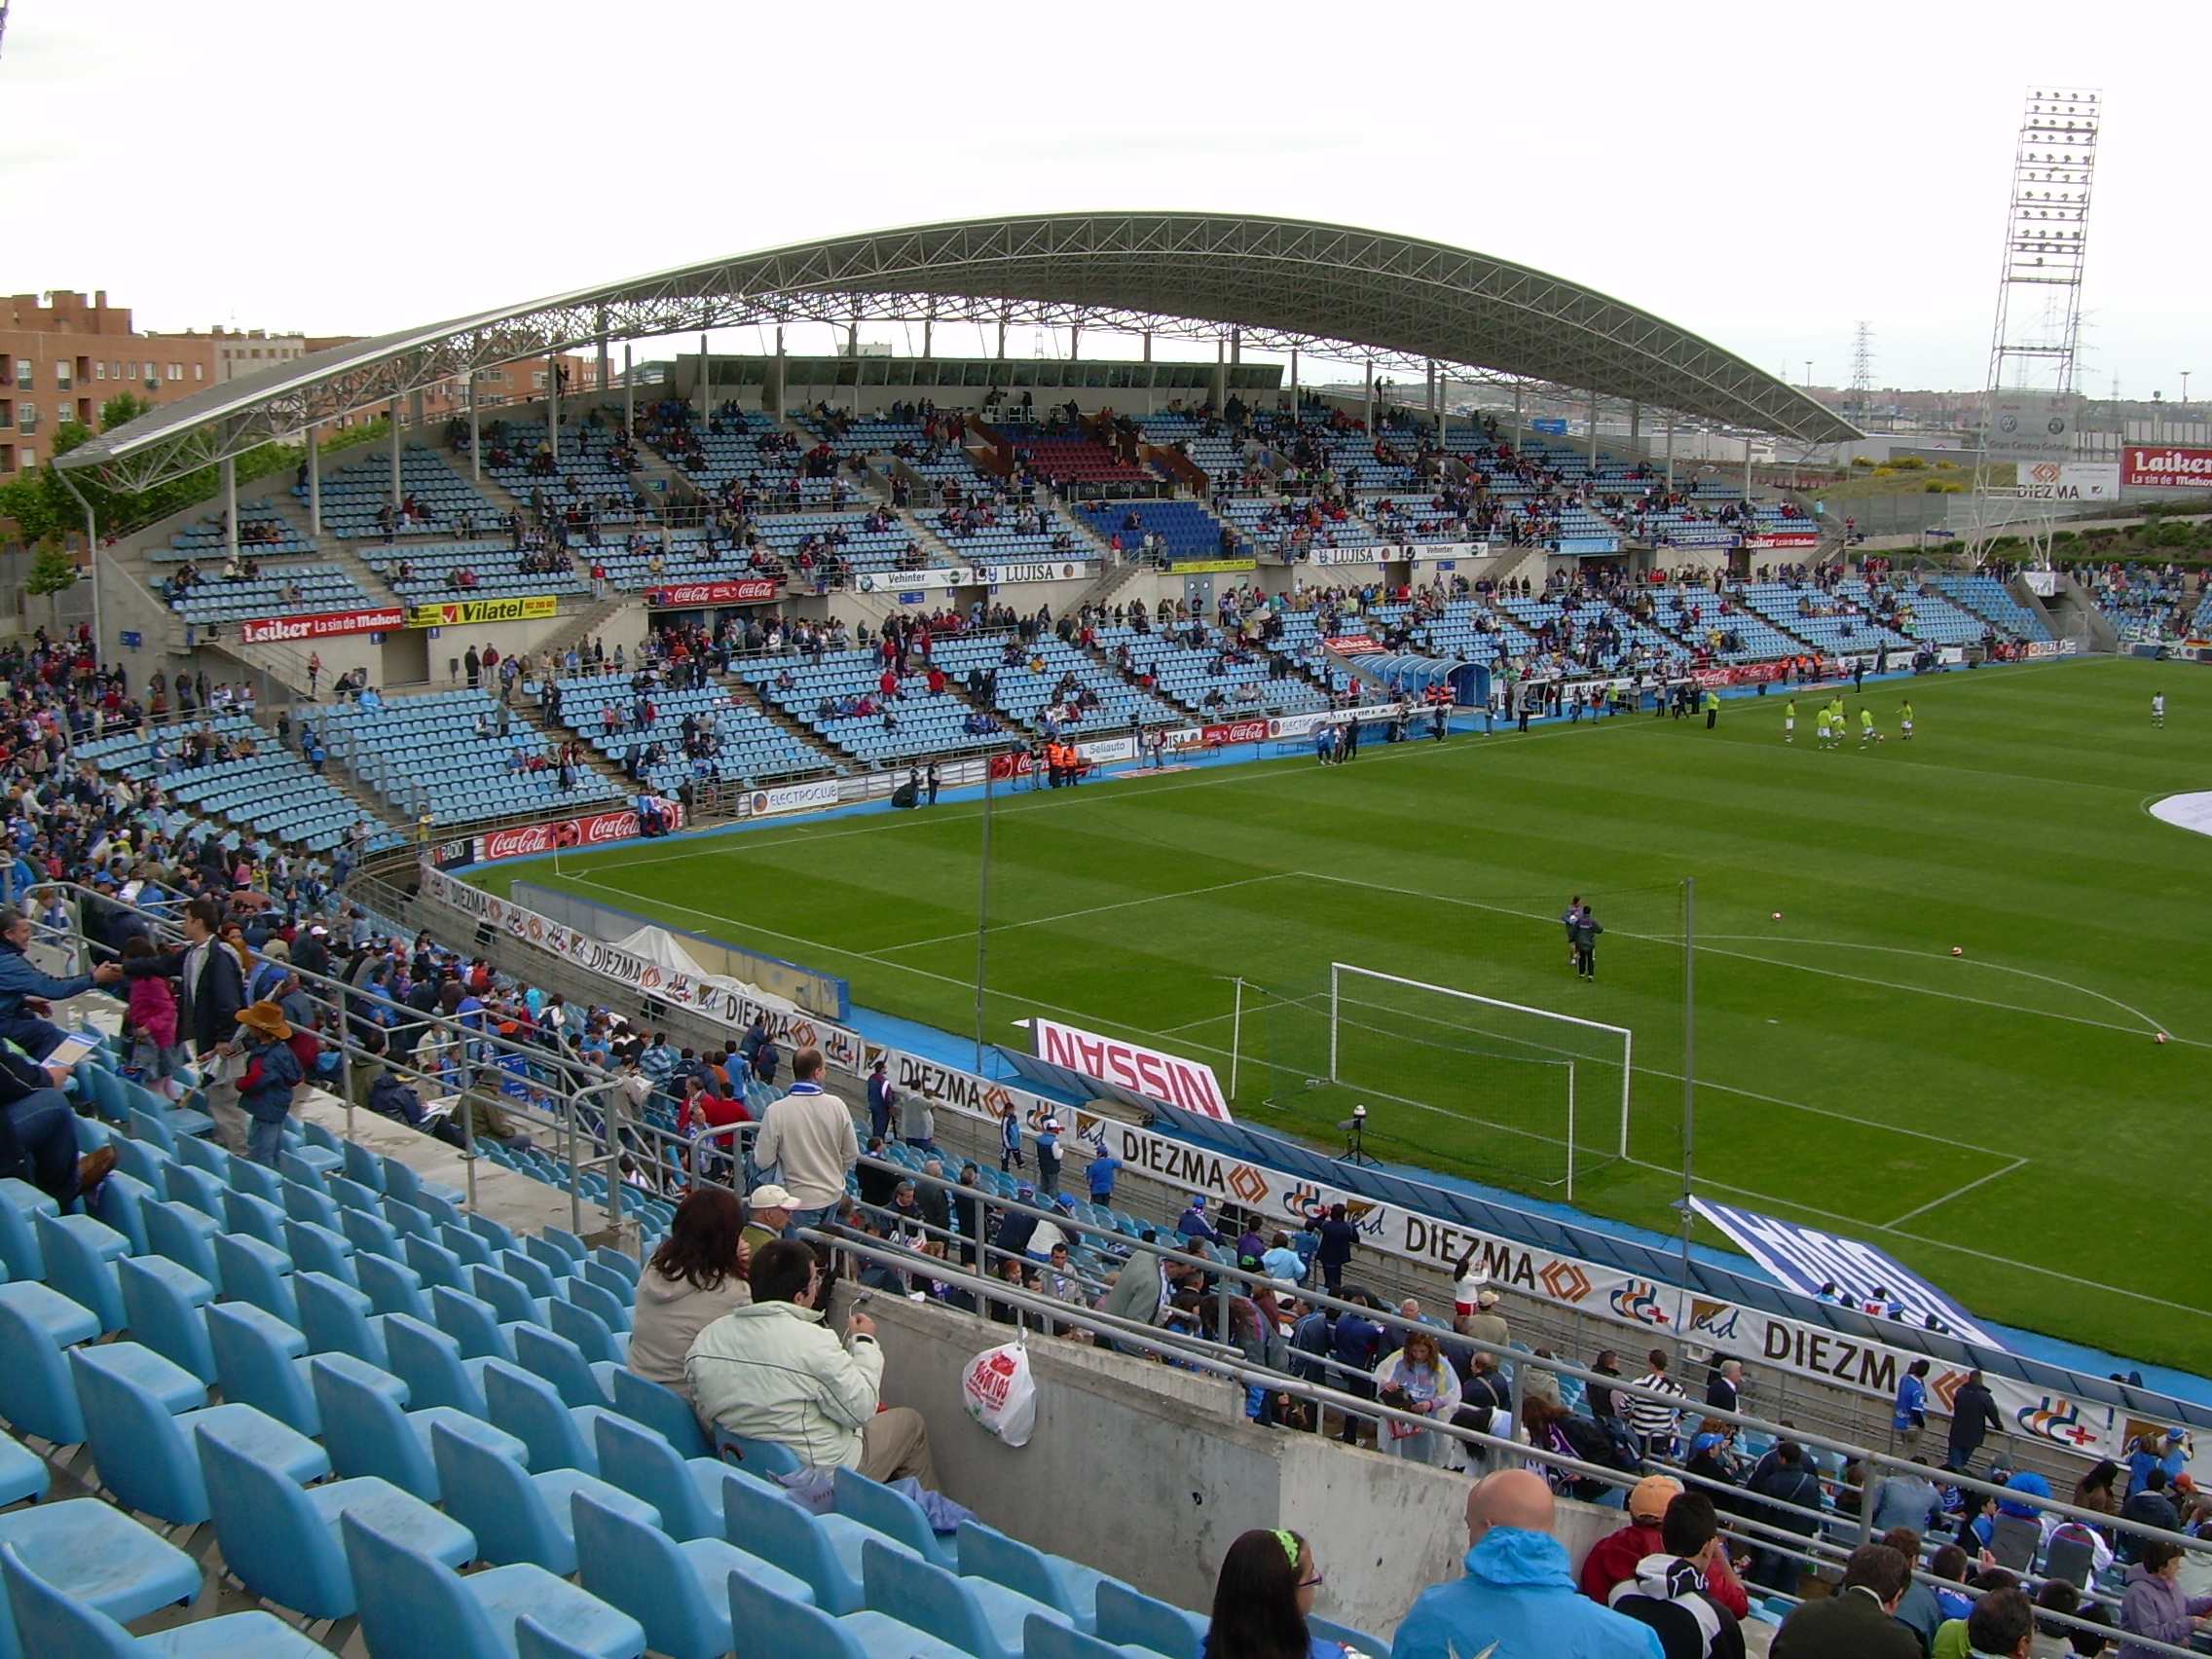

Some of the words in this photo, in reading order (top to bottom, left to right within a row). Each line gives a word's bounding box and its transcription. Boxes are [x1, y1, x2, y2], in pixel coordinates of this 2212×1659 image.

[2016, 484, 2080, 499] DIEZMA
[2131, 473, 2143, 484] La
[2160, 475, 2172, 485] de
[2176, 475, 2212, 486] Maho
[1333, 548, 1375, 564] LUJISA
[888, 573, 926, 584] Vehinter
[1005, 565, 1055, 582] LUJISA
[461, 600, 525, 622] Vilatel
[243, 620, 313, 643] Laiker
[314, 620, 327, 633] La
[344, 616, 355, 629] de
[356, 613, 401, 628] Mahou
[770, 785, 837, 806] ELECTROCLUB
[589, 944, 642, 982] DIEZMA
[725, 994, 792, 1043] DIEZMA
[899, 1057, 982, 1113] DIEZMA
[1045, 1025, 1224, 1121] NISSAN
[1123, 1131, 1226, 1193] DIEZMA
[1405, 1215, 1535, 1291] DIEZMA
[1695, 1309, 1740, 1339] eid
[1764, 1320, 1906, 1394] DIEZM
